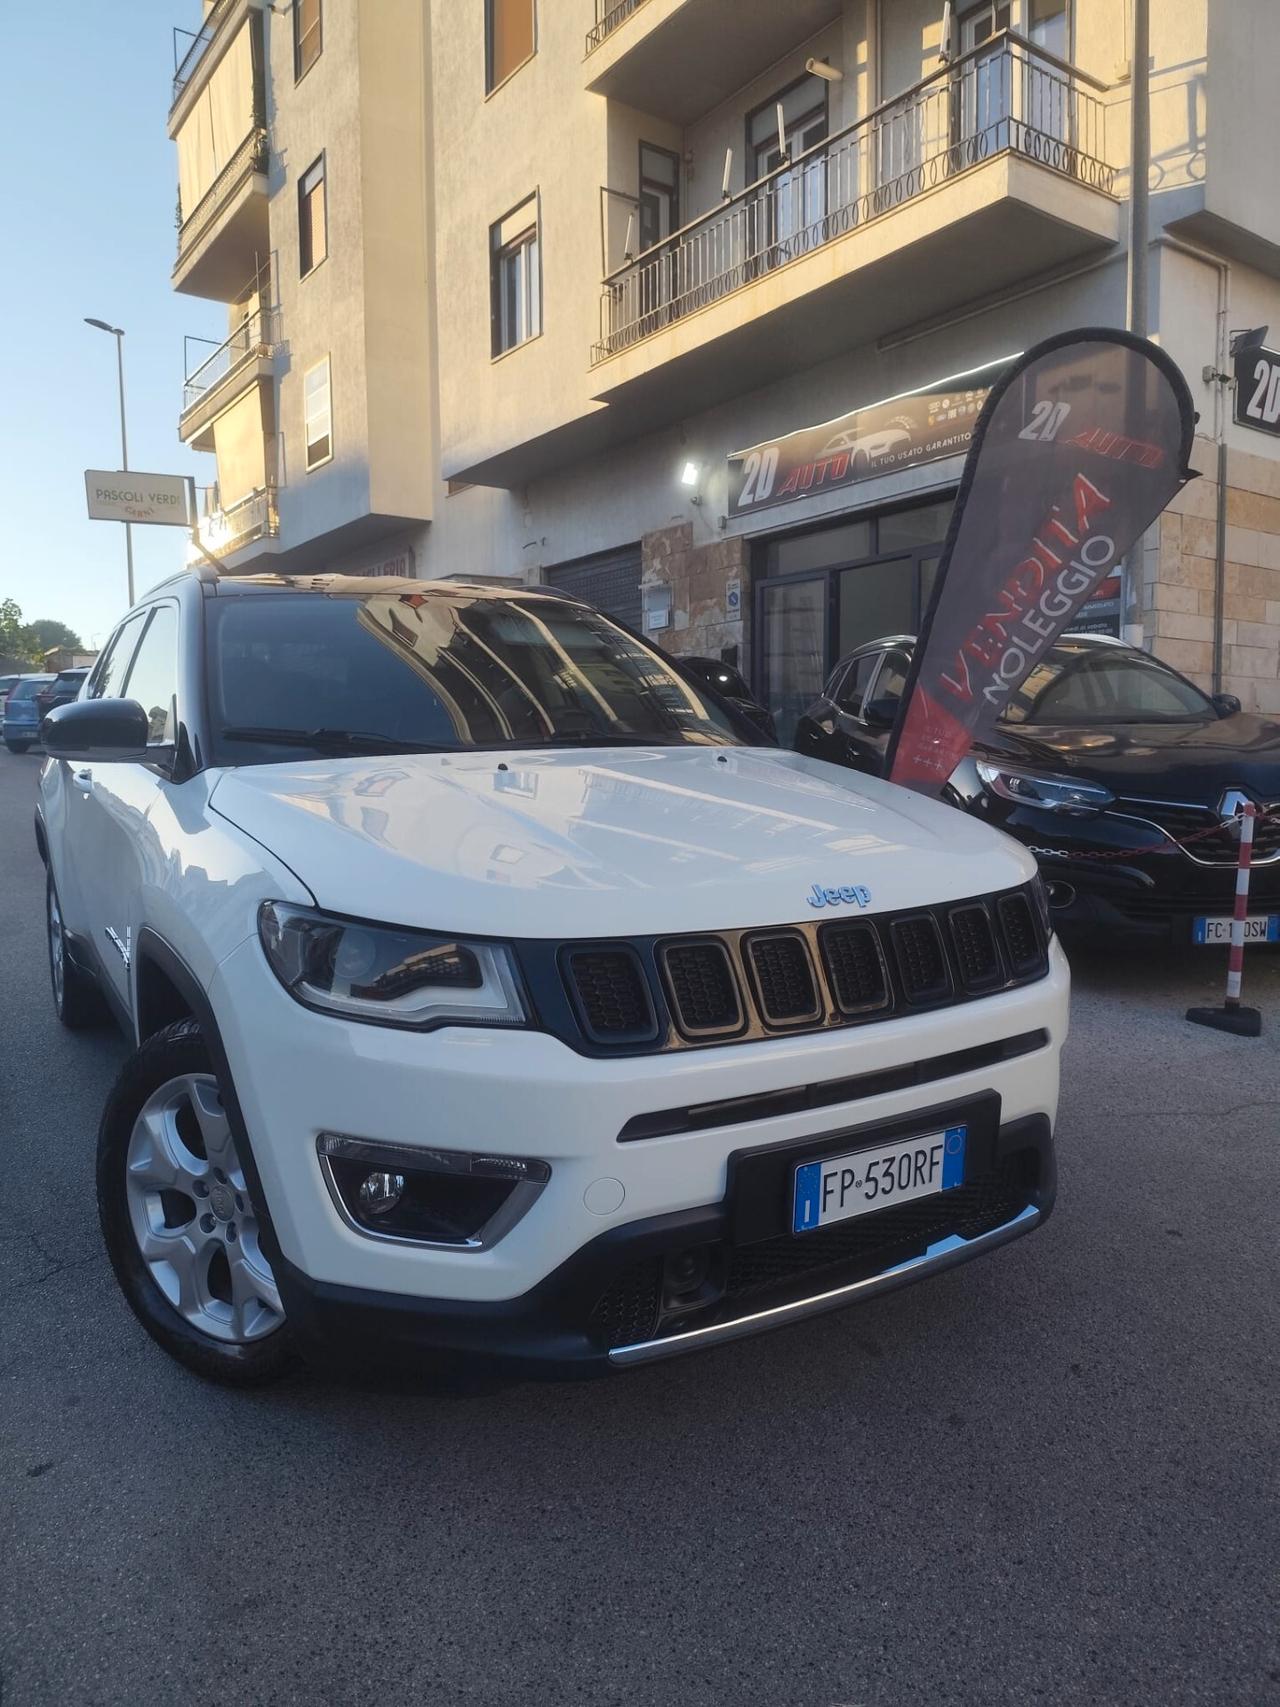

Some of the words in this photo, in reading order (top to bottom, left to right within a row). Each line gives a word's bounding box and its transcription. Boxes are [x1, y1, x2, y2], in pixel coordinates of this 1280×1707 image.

[1246, 359, 1280, 423] 2D
[871, 460, 877, 468] IL
[880, 455, 895, 465] TUO
[898, 446, 923, 460] USATO
[926, 431, 972, 451] GARANTITO
[1018, 400, 1071, 441] 2D
[1062, 427, 1164, 470] AUTO
[96, 489, 143, 503] PASCOLI
[738, 447, 779, 506] 2D
[776, 453, 849, 497] AUTO
[937, 472, 1111, 703] VENDITA
[983, 535, 1115, 704] NOLEGGIO
[807, 884, 871, 908] Jeep
[1229, 921, 1267, 938] 10SW
